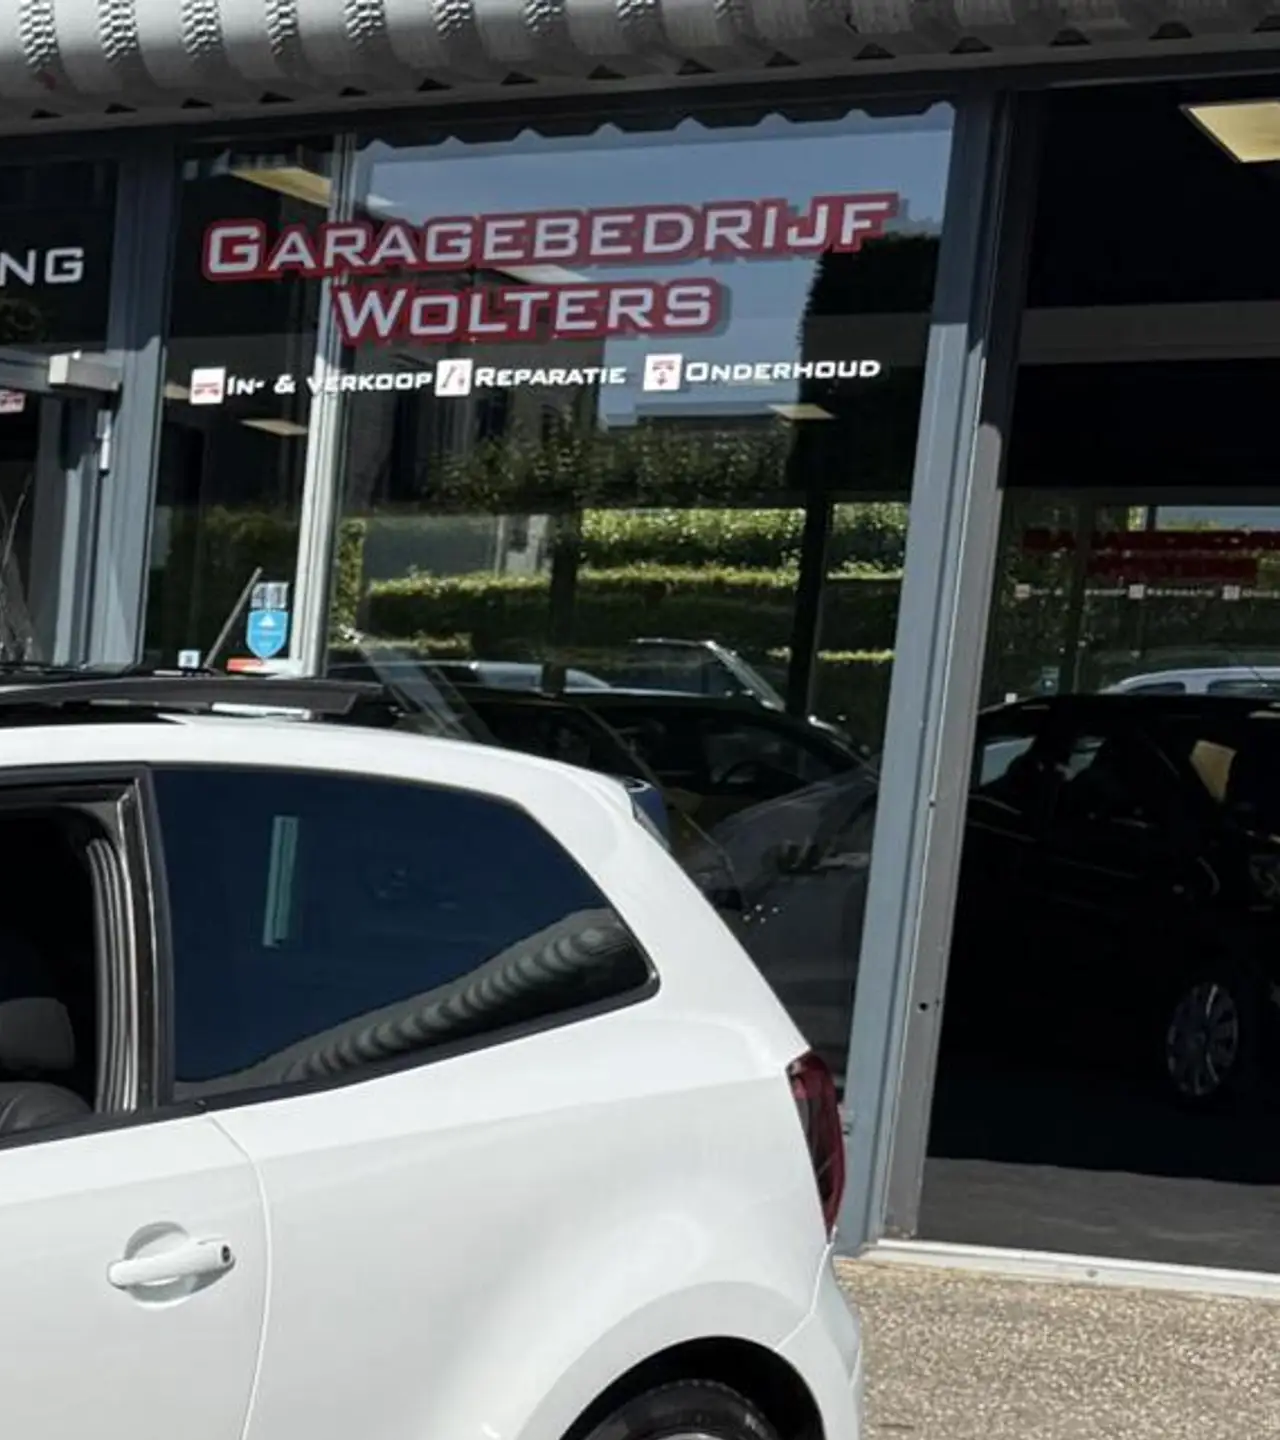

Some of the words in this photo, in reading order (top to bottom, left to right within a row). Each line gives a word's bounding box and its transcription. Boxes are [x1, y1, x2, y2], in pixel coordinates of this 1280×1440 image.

[207, 200, 890, 275] GARAGEBEDRIJF
[337, 284, 712, 339] WOLTERS
[273, 373, 296, 395] &
[305, 371, 434, 397] VERKOOP
[473, 366, 628, 388] REPARATIE
[685, 359, 882, 382] ONDERHOUD
